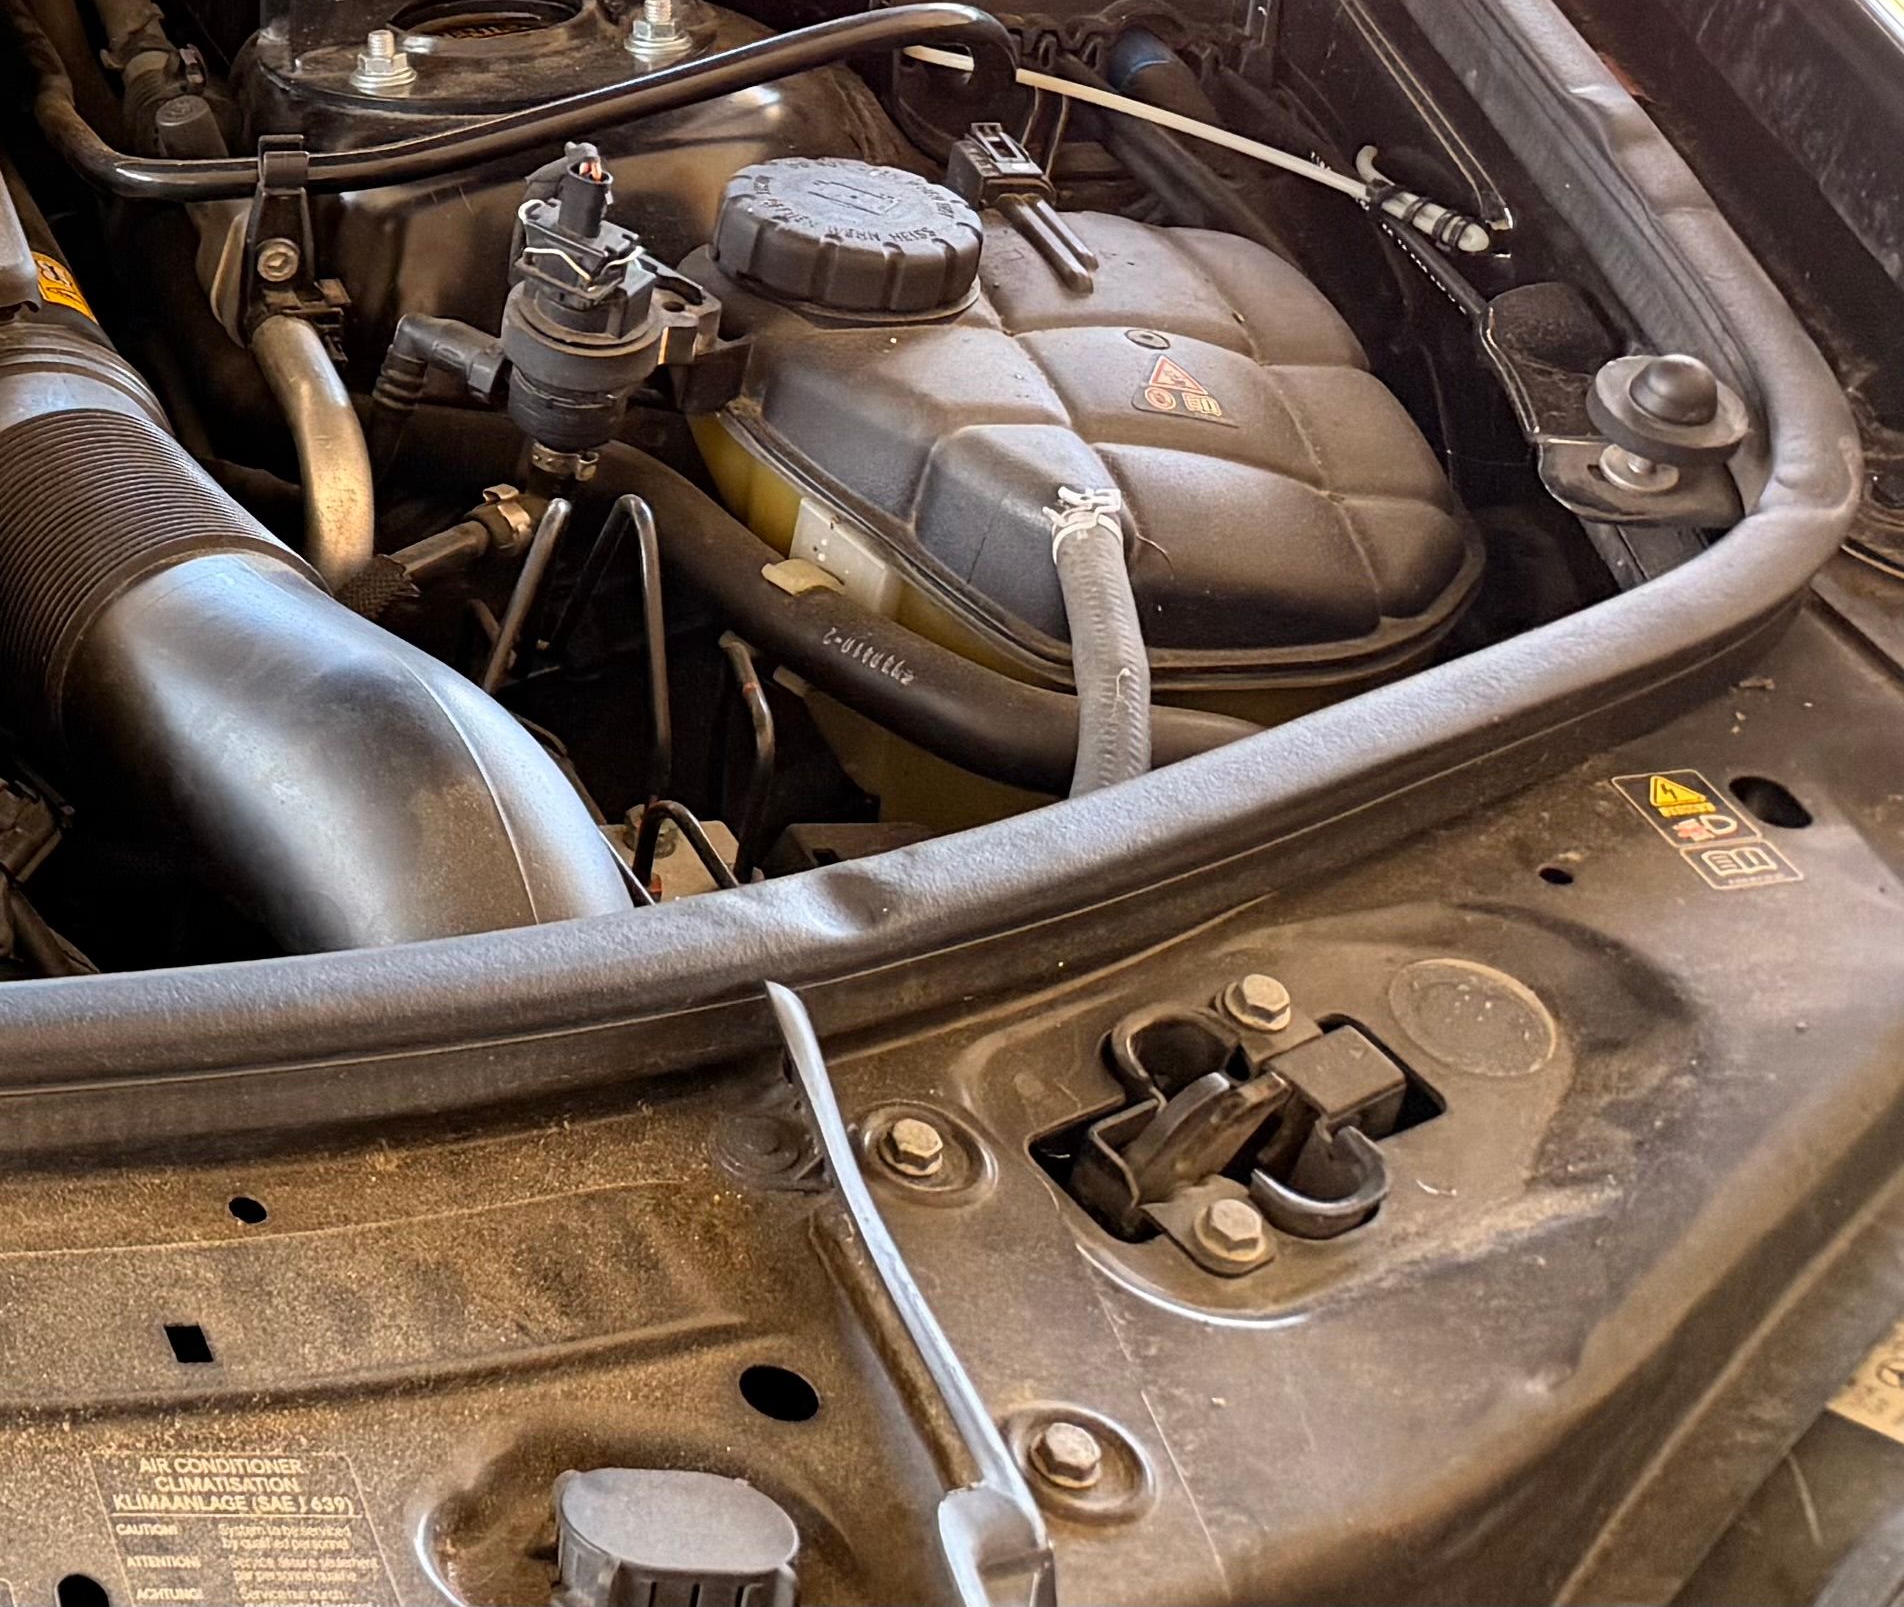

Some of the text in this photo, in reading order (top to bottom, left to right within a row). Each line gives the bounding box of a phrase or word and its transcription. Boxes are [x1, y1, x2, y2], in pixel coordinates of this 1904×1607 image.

[139, 1457, 305, 1475] AIR CONDITIONER
[154, 1475, 302, 1493] CLIMATISATION
[112, 1493, 249, 1511] KLIMAANLAGE
[252, 1494, 296, 1513] (SAE
[310, 1496, 354, 1516] 639)
